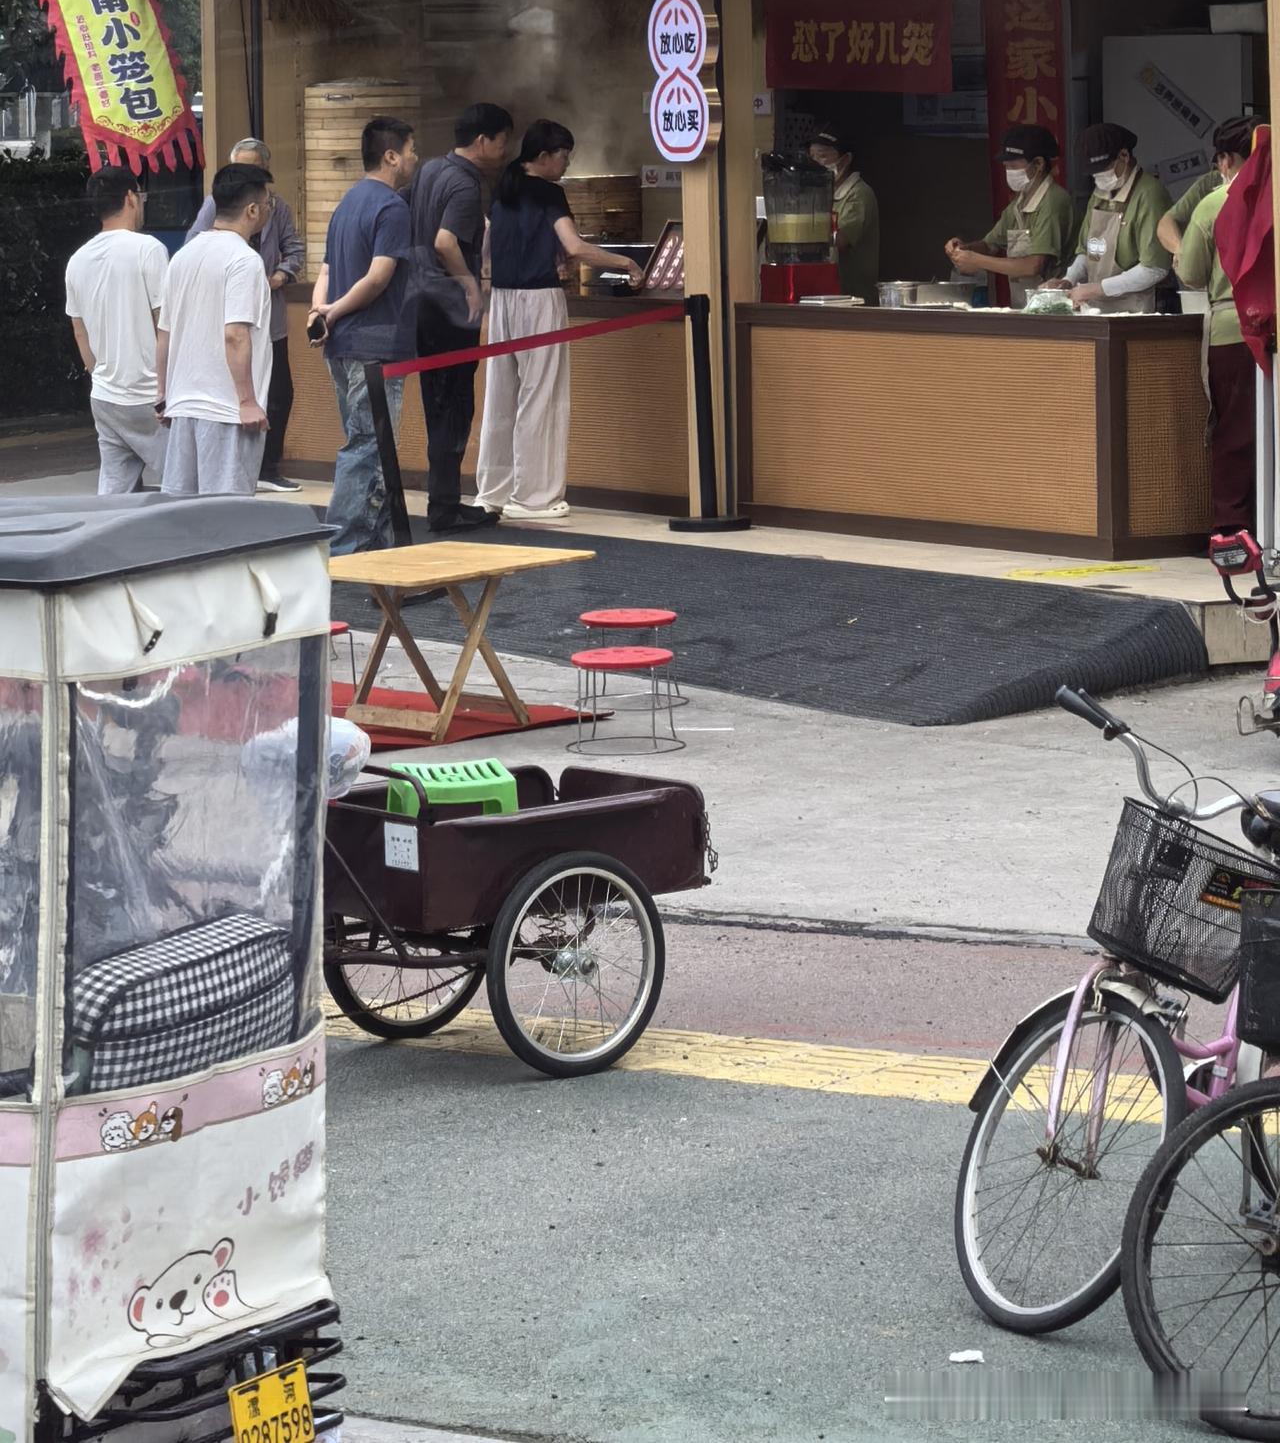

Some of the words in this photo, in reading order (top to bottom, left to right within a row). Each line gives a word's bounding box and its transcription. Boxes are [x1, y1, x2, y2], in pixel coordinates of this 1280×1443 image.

[659, 31, 697, 55] 放心吃
[662, 108, 700, 133] 放心买
